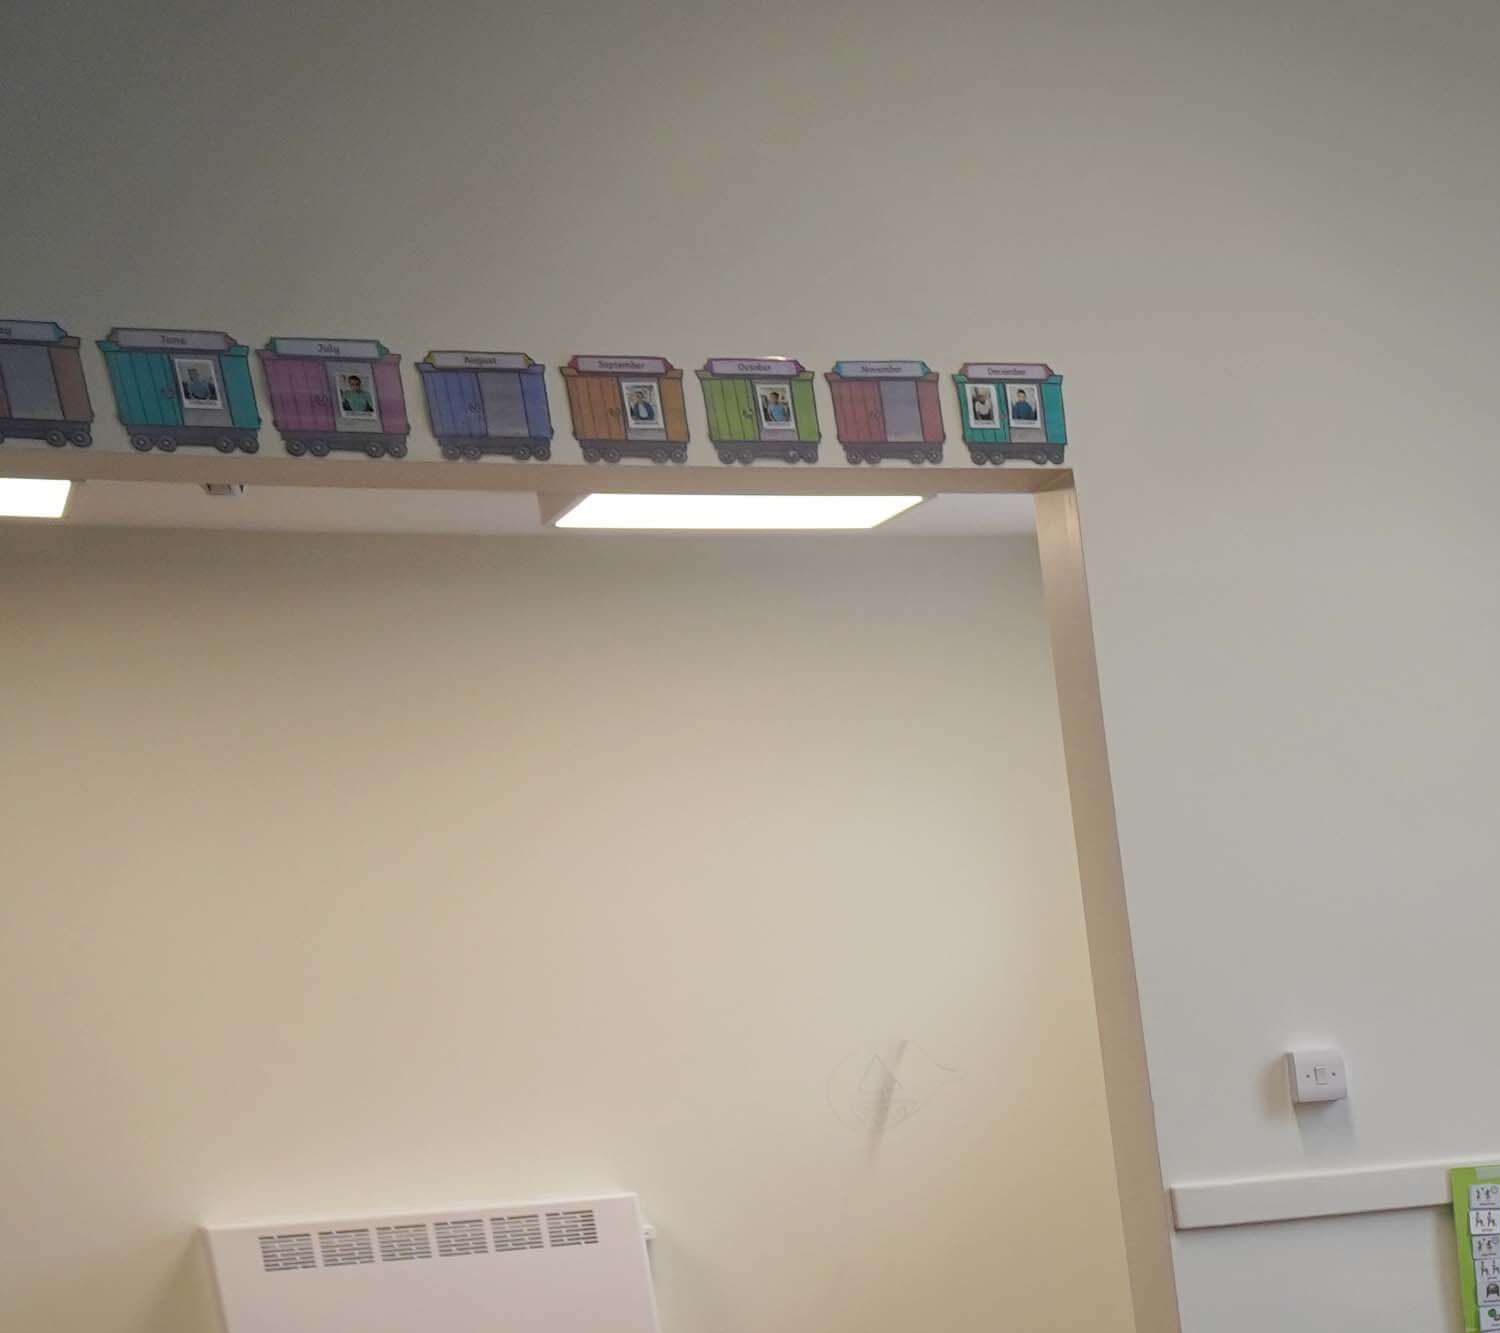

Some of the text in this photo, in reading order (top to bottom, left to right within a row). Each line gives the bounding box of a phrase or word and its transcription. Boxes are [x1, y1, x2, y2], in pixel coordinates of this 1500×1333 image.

[160, 333, 187, 345] June
[317, 343, 340, 356] July
[464, 356, 497, 366] August
[598, 359, 646, 371] September
[738, 362, 771, 373] October
[861, 364, 903, 374] November
[987, 367, 1026, 377] December
